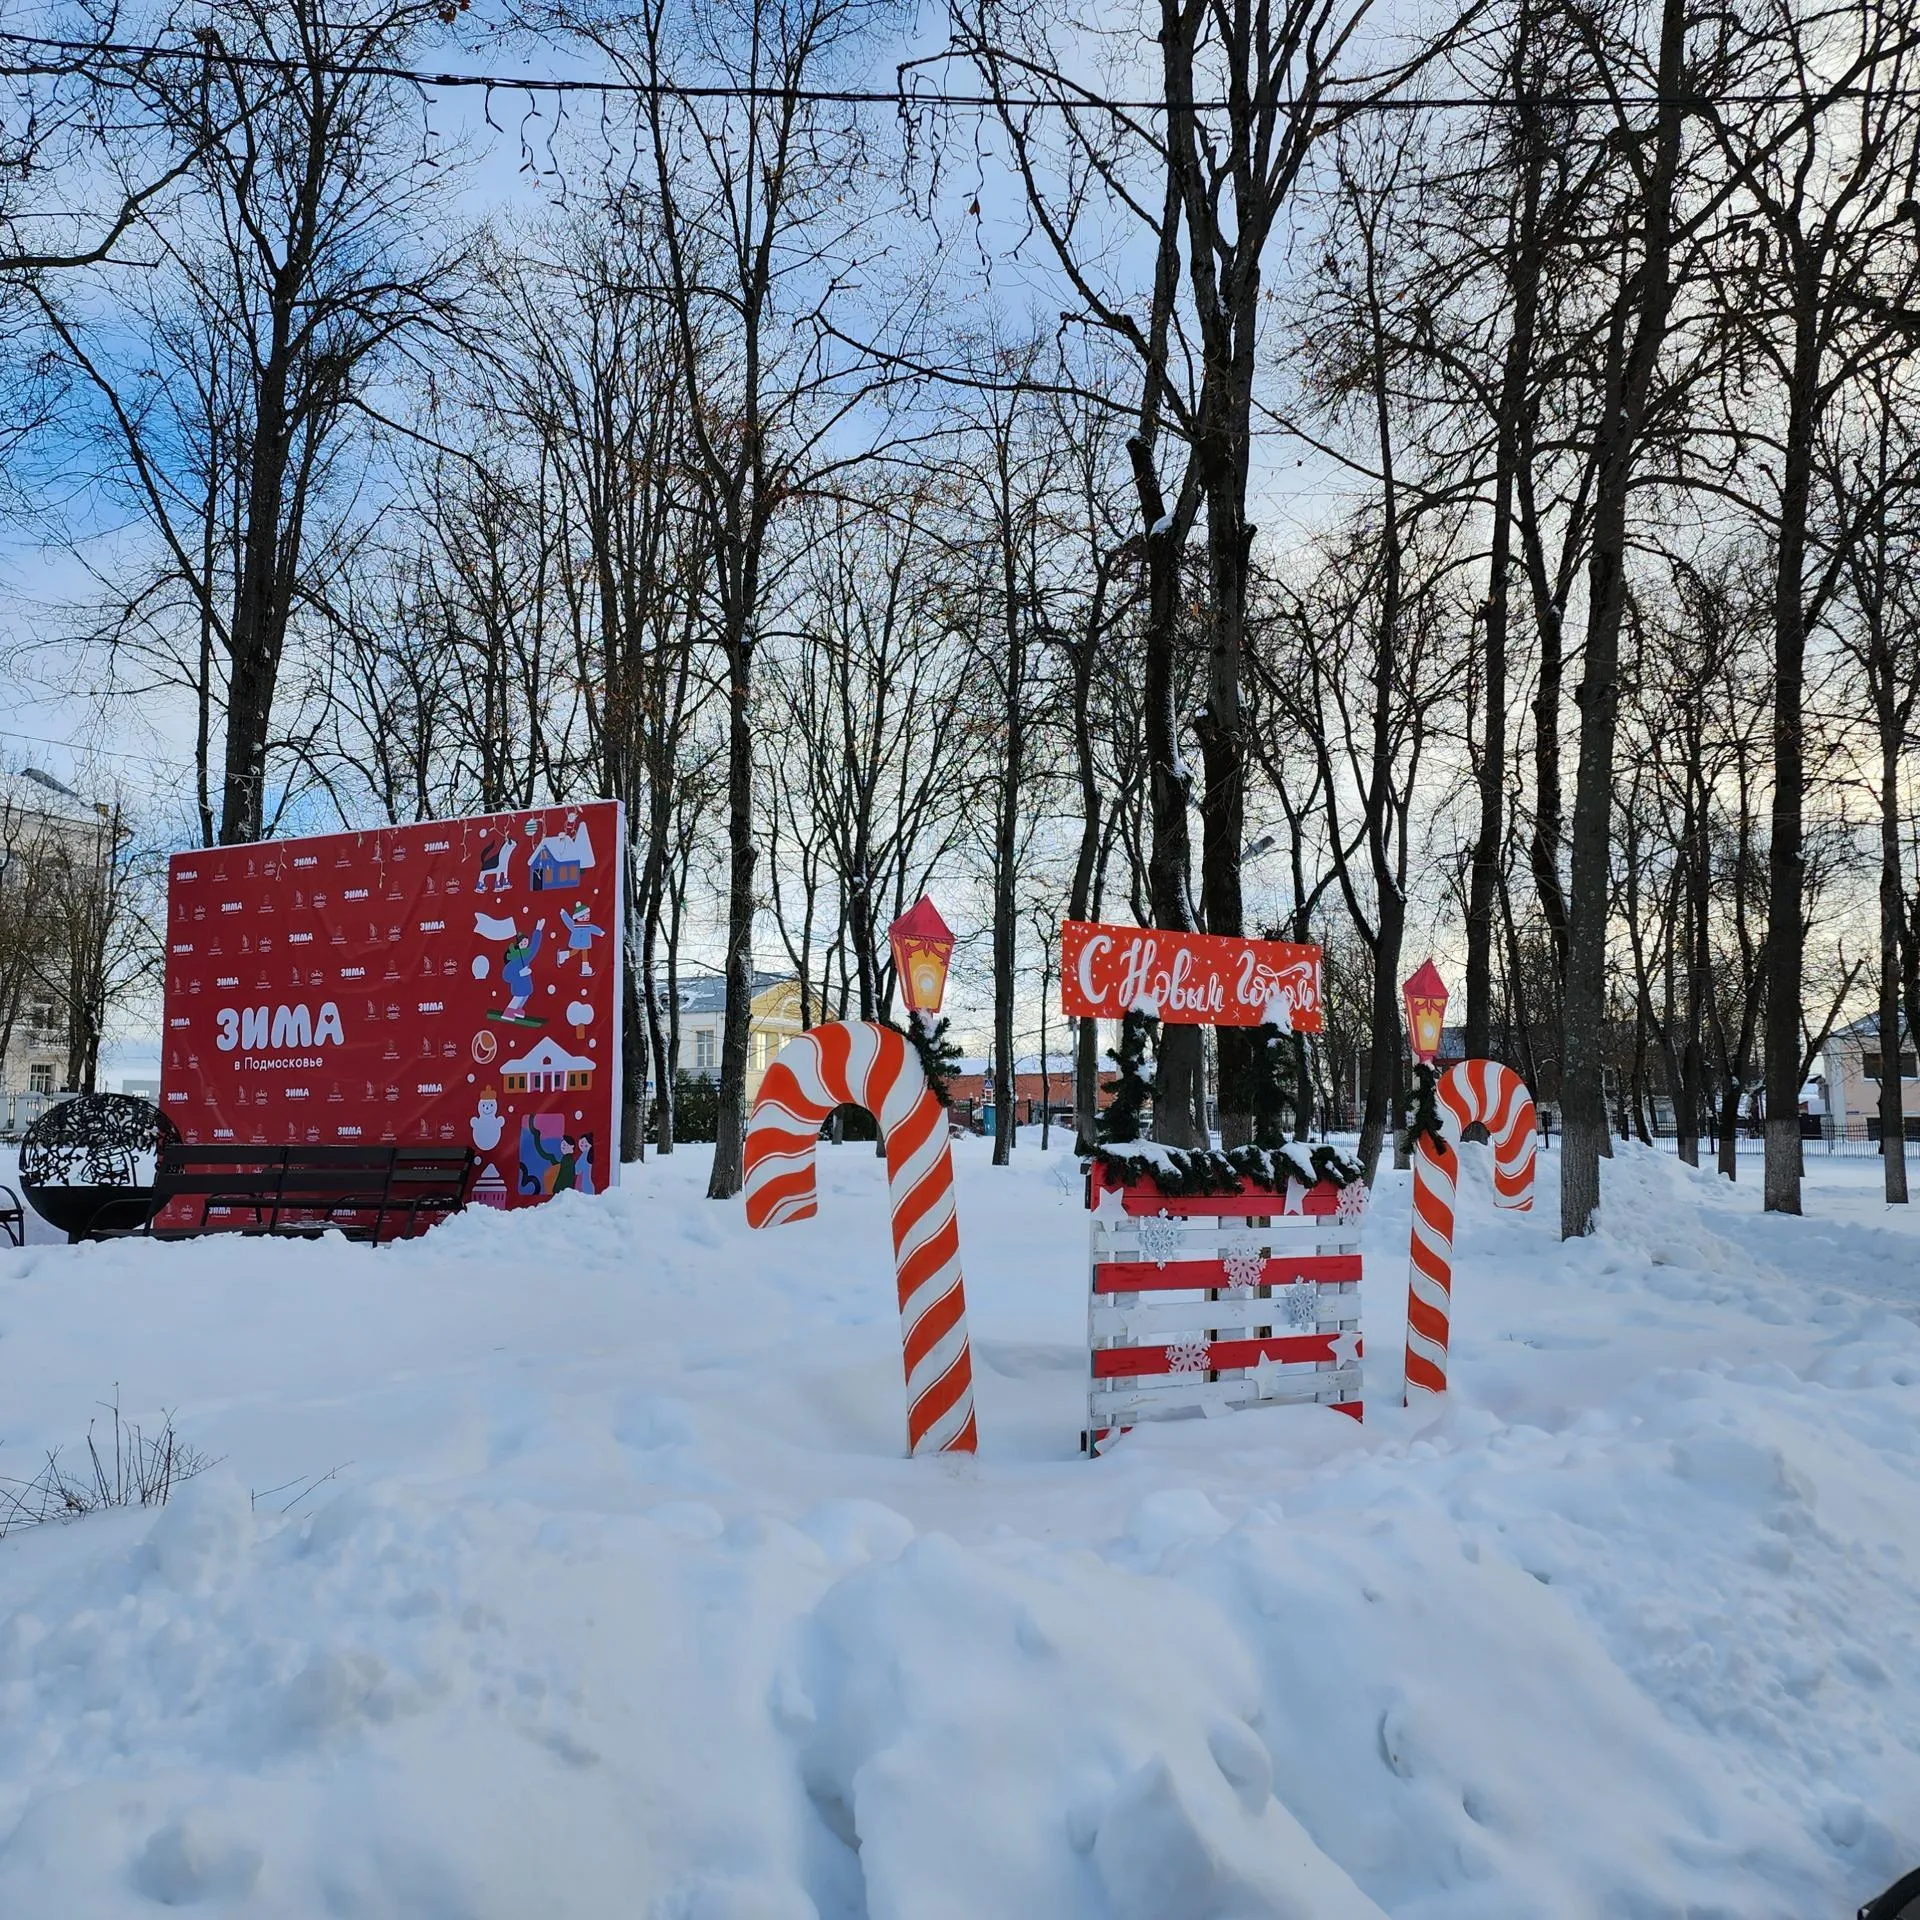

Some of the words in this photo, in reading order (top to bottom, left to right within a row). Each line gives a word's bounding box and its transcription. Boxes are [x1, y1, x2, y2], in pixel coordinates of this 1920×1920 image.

[424, 840, 450, 853] ЗИМА
[293, 856, 318, 868] ЗИМА
[176, 870, 198, 881] ЗИМА
[344, 888, 369, 900] ЗИМА
[221, 901, 243, 913] ЗИМА
[419, 920, 446, 932] ЗИМА
[288, 932, 313, 944] ЗИМА
[172, 943, 194, 954] ЗИМА
[340, 966, 366, 978] ЗИМА
[1078, 935, 1112, 1004] С
[1119, 938, 1225, 1013] Новым
[216, 976, 239, 988] ЗИМА
[417, 1001, 444, 1012] ЗИМА
[170, 1017, 191, 1027] ЗИМА
[216, 1001, 345, 1051] ЗИМА
[234, 1061, 240, 1071] в
[244, 1056, 323, 1072] Подмосковье
[285, 1087, 310, 1098] ЗИМА
[417, 1083, 444, 1094] ЗИМА
[167, 1091, 189, 1101] ЗИМА
[213, 1128, 235, 1138] ЗИМА
[337, 1126, 363, 1137] ЗИМА
